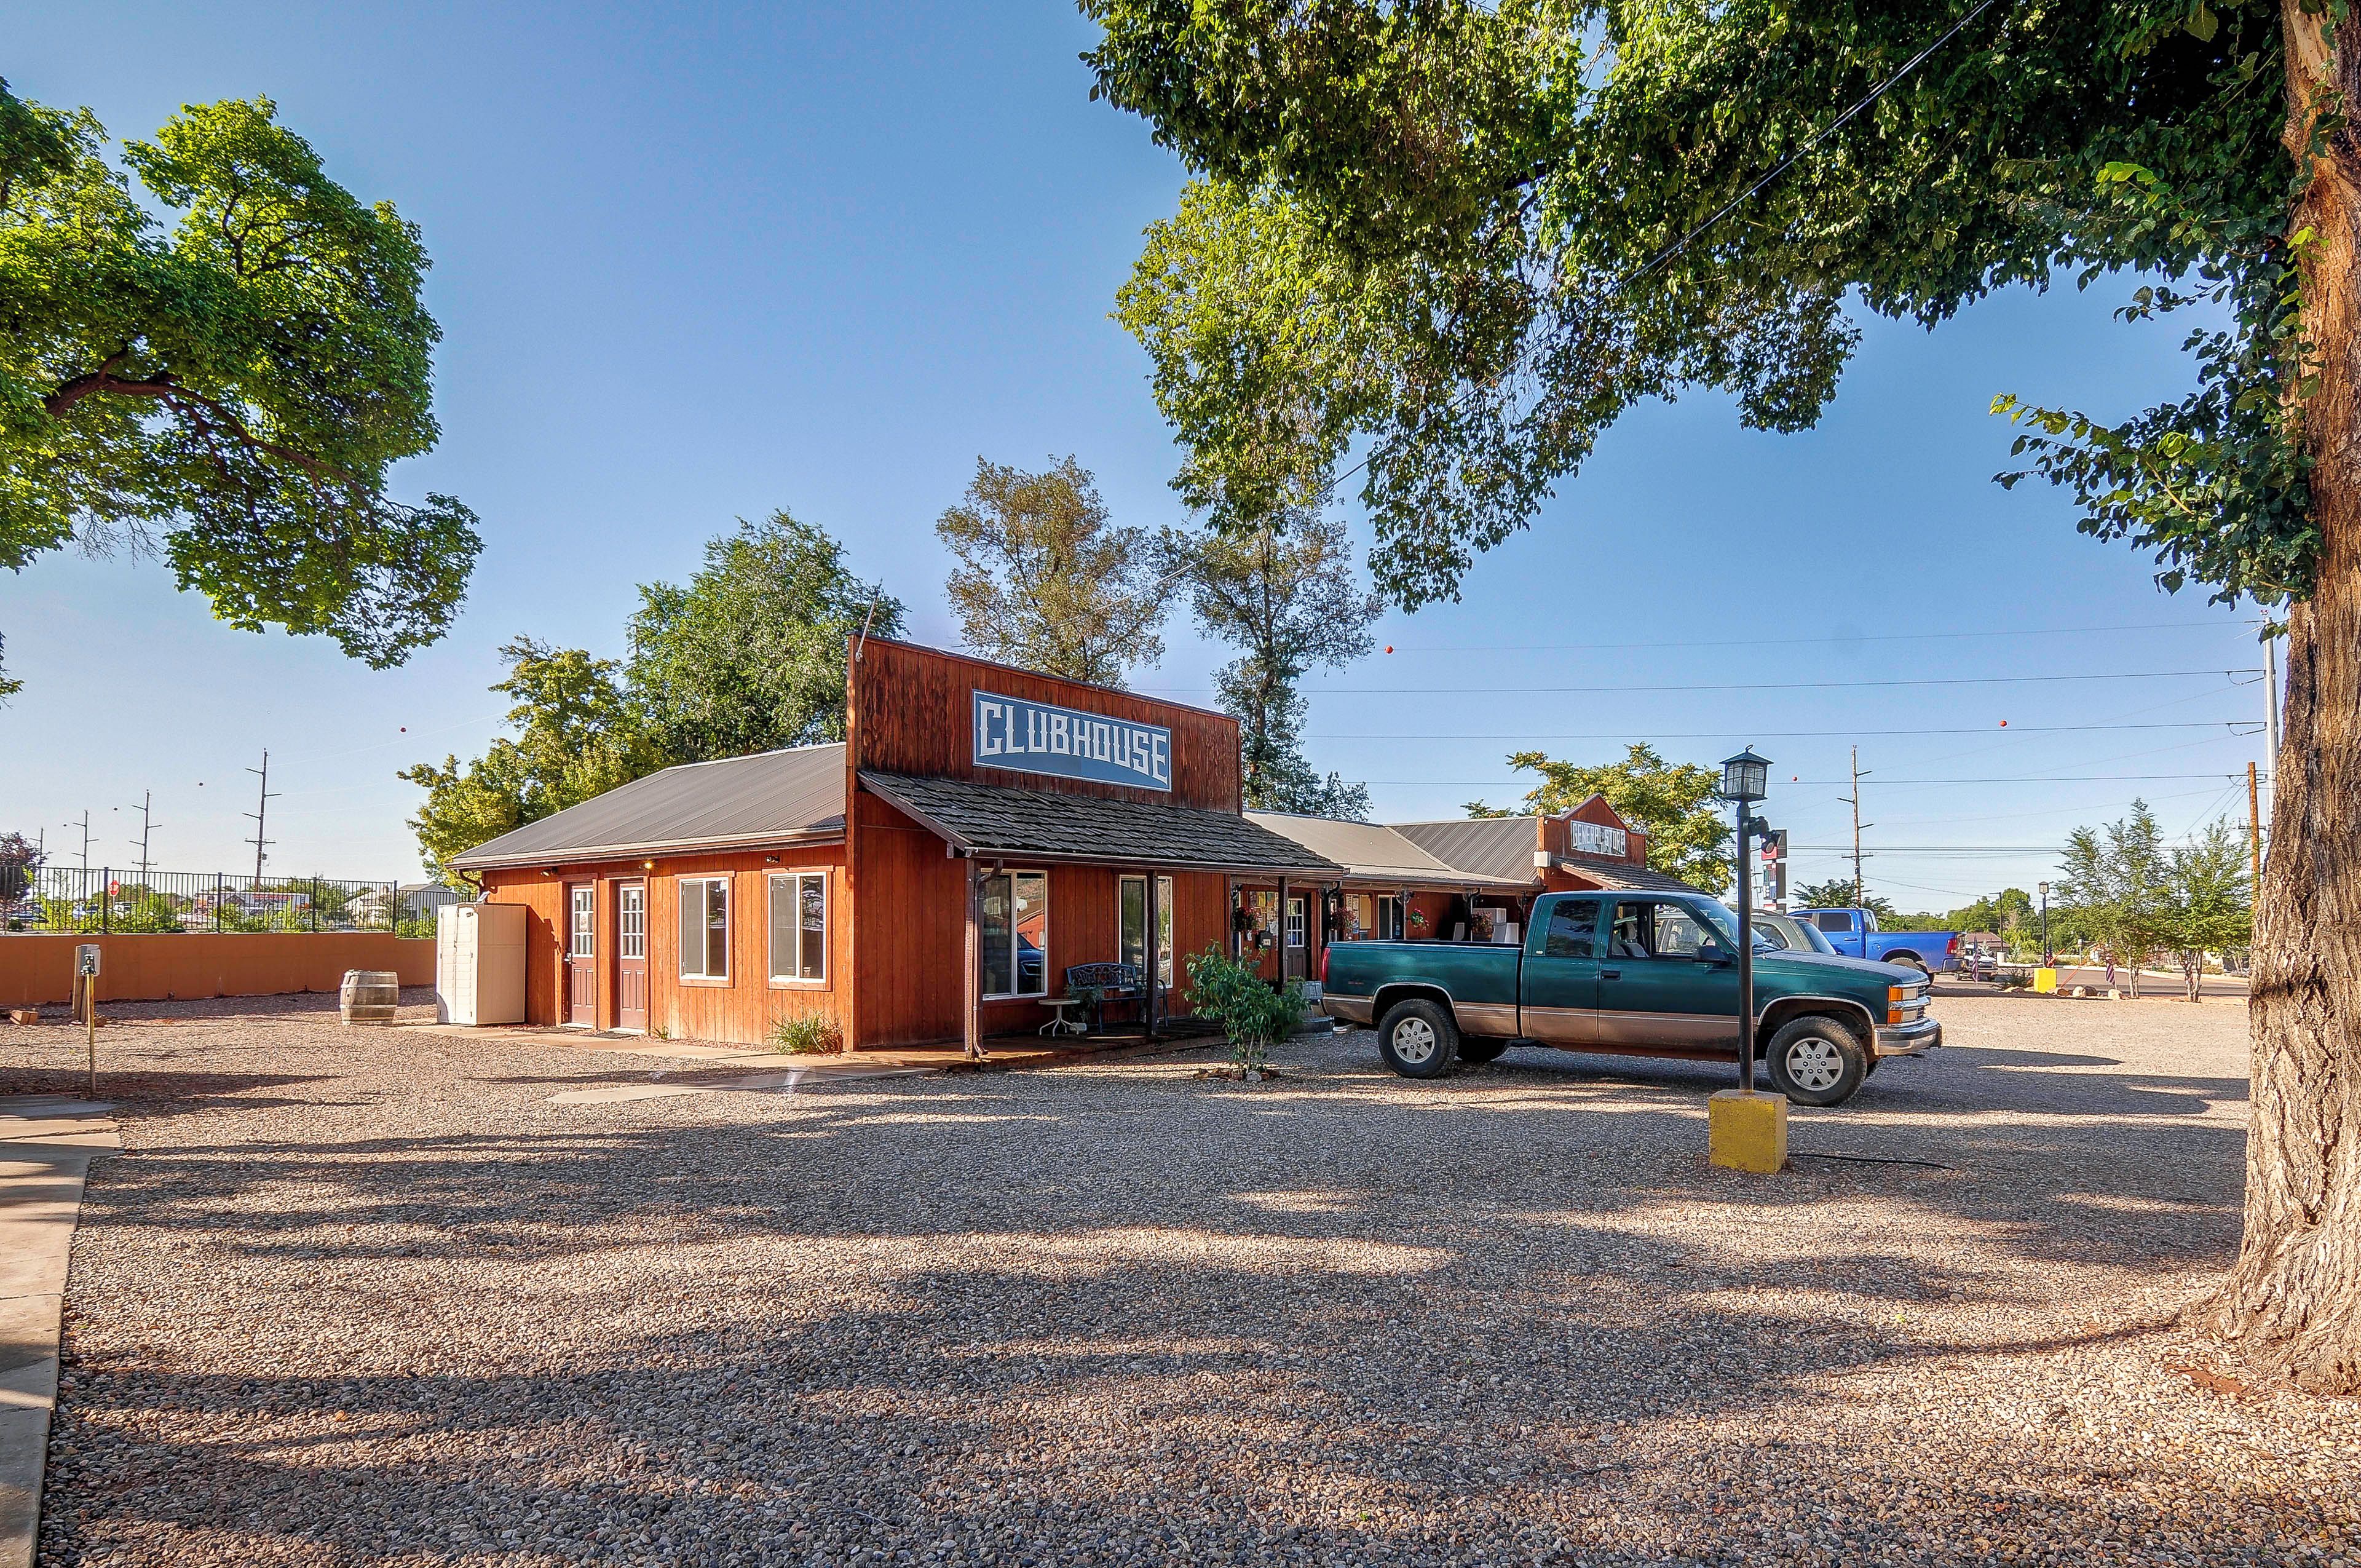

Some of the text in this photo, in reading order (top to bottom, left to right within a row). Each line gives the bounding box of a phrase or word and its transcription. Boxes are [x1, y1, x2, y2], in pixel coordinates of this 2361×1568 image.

[979, 700, 1168, 786] CLUBHOUSE
[1572, 823, 1625, 855] GENERAL STORE
